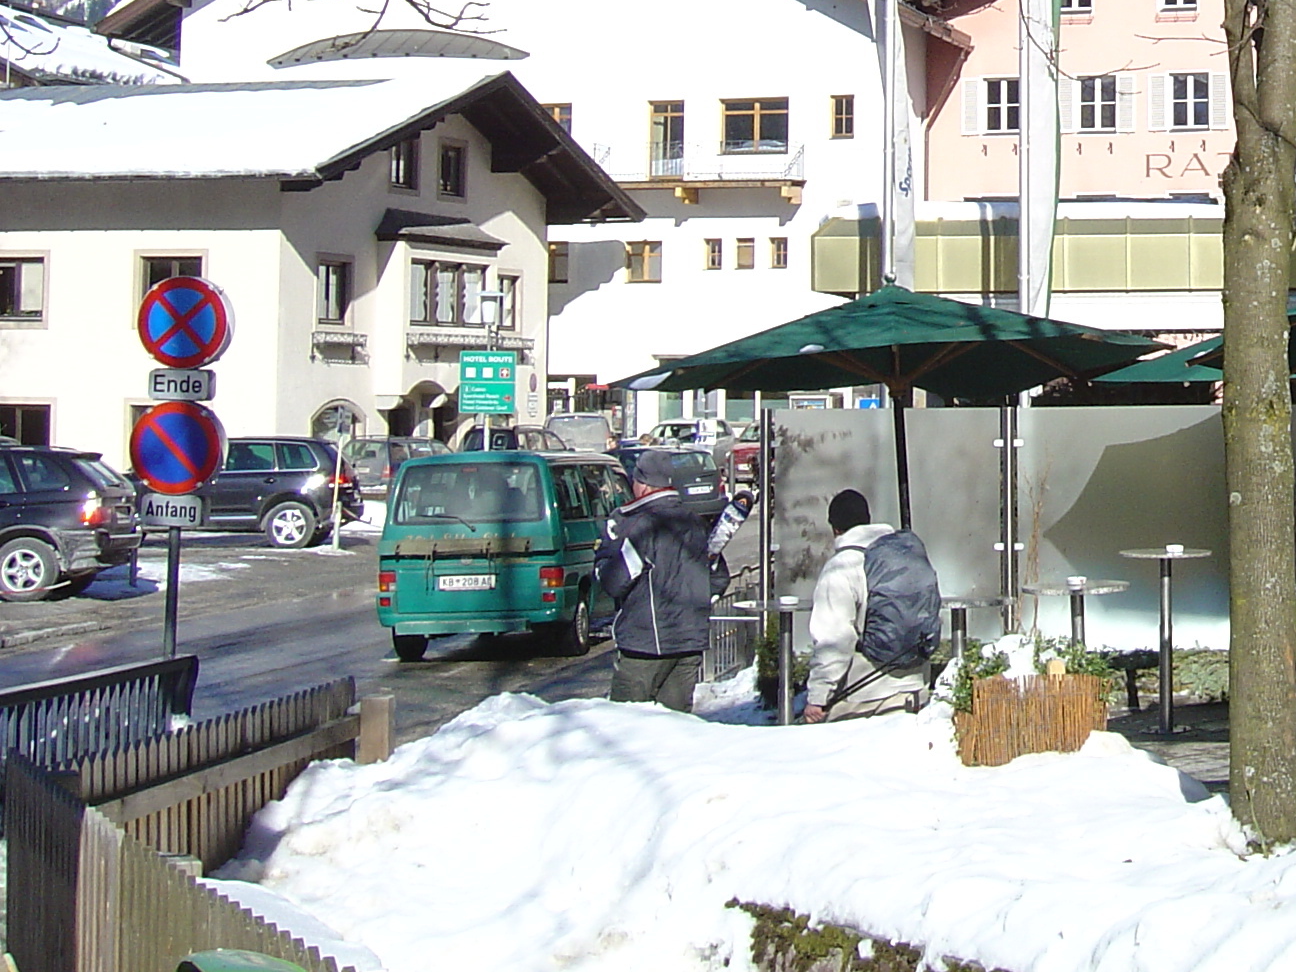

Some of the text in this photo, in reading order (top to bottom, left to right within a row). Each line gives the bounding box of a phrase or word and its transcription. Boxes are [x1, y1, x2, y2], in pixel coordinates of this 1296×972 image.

[488, 356, 513, 364] ROUTE
[153, 374, 202, 393] Ende
[146, 500, 197, 522] Anfang
